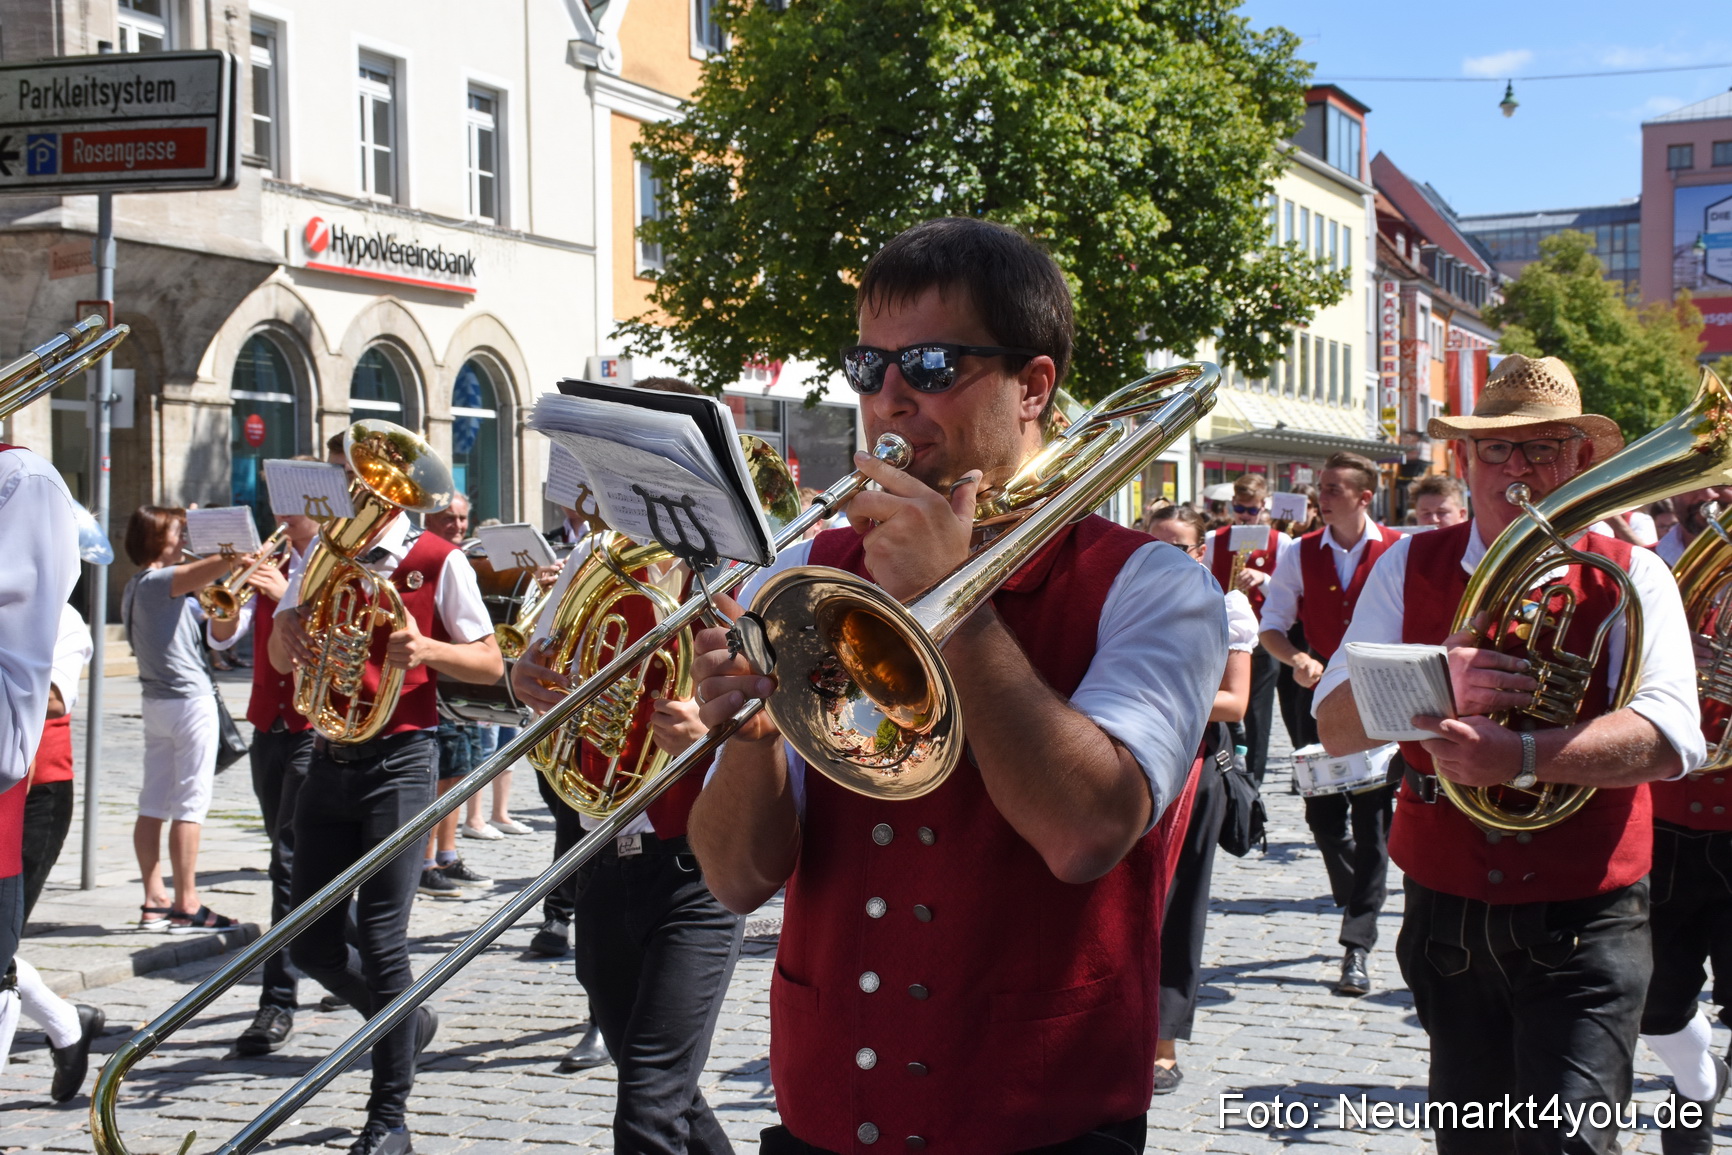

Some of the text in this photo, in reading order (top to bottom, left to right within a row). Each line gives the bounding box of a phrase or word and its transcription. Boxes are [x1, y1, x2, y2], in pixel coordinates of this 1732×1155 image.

[19, 75, 176, 114] Parkleitsystem
[35, 138, 176, 172] P Rosengasse
[332, 224, 476, 277] HypoVereinsbank
